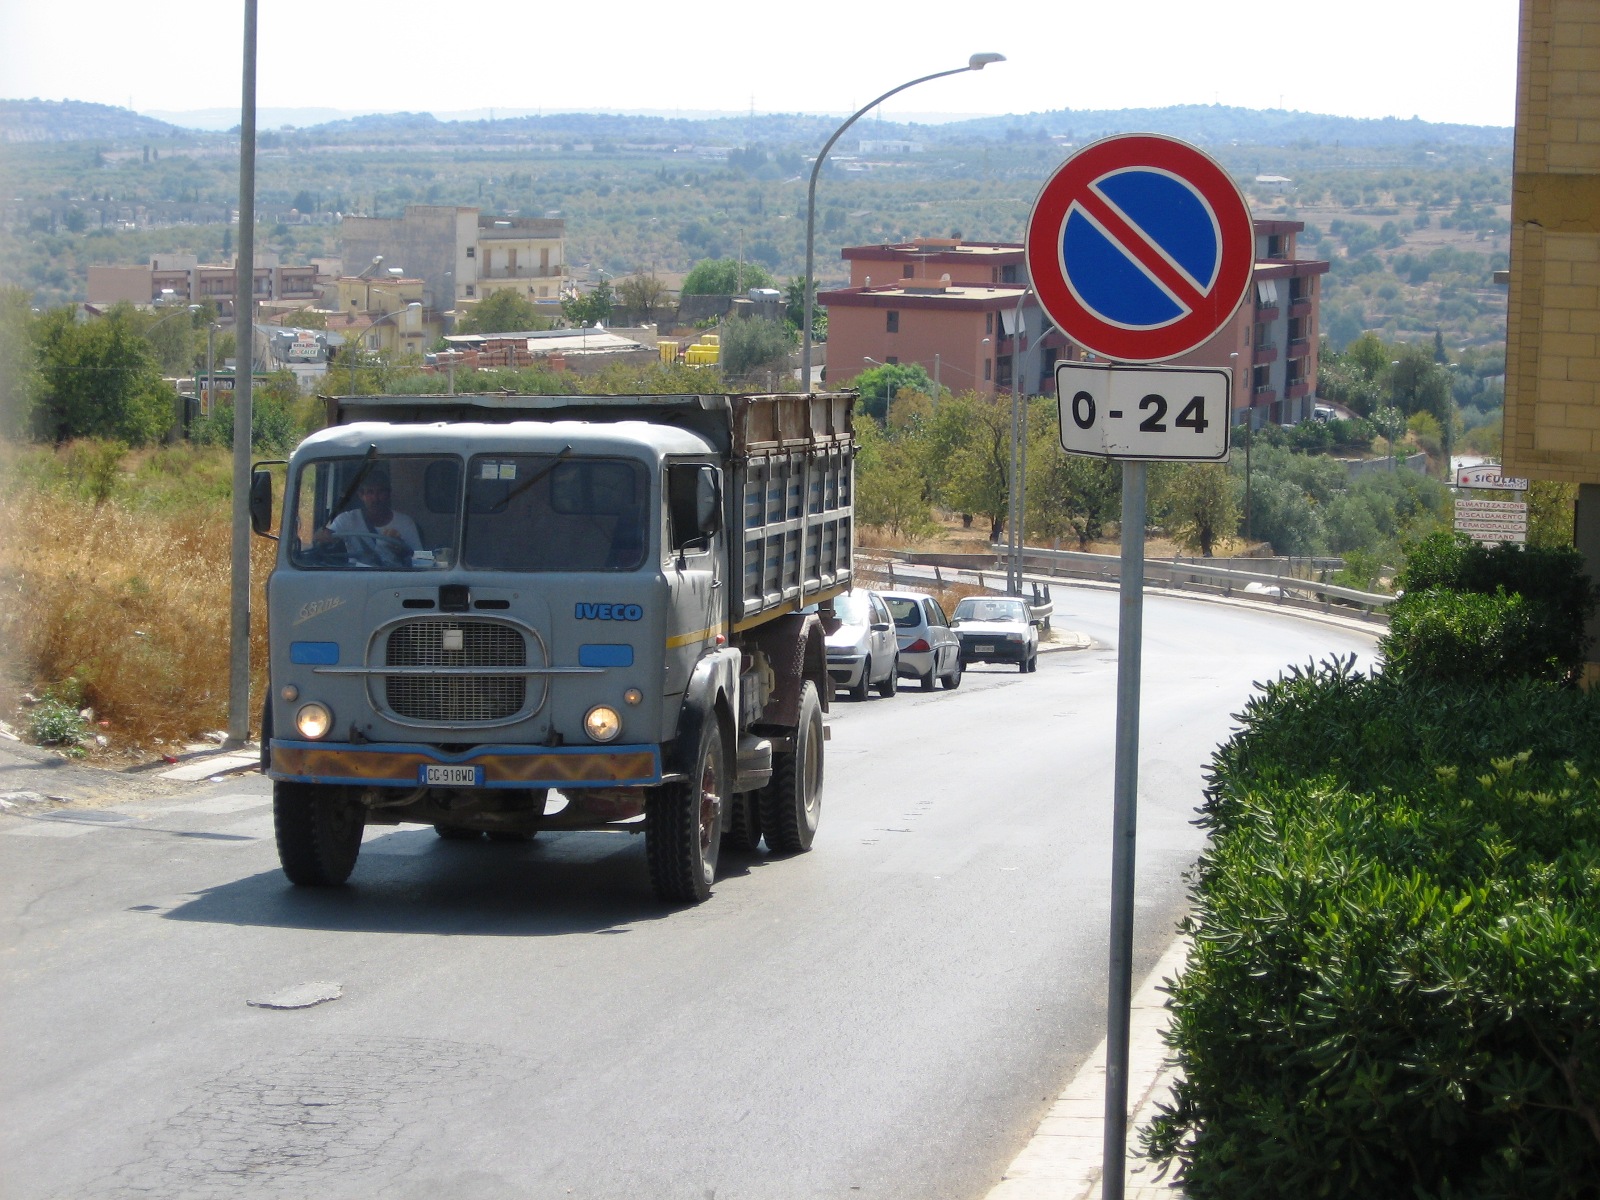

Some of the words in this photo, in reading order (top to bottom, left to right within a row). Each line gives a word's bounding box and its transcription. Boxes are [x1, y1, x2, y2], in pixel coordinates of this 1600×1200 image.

[1474, 474, 1516, 483] SICULA
[1456, 501, 1525, 509] CLIMATIZZAZIONE
[1457, 511, 1523, 520] RISCALDAMENTO
[1457, 521, 1523, 530] TERMOIDRAULICA
[1468, 533, 1515, 541] ASMETANO
[574, 602, 644, 621] IVECO
